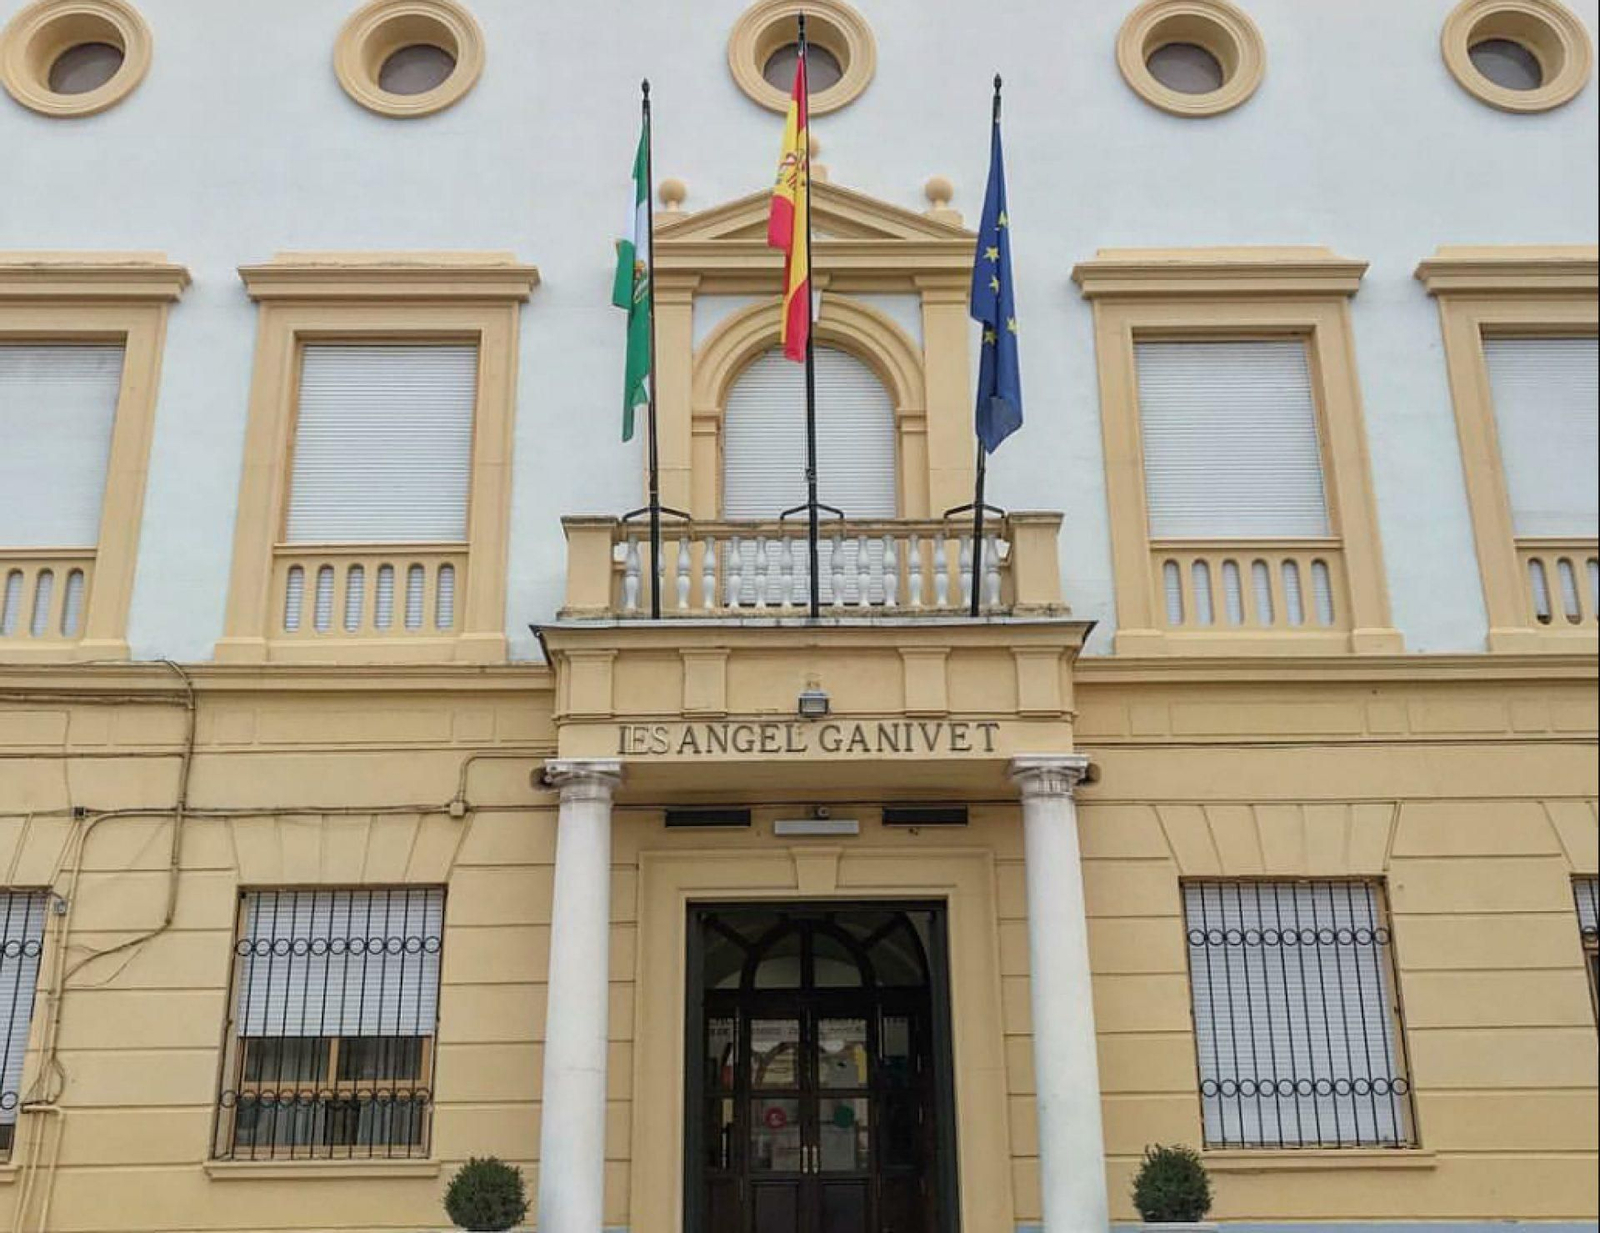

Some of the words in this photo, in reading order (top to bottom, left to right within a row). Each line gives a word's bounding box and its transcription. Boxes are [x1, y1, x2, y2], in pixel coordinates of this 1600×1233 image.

[618, 725, 669, 755] IES
[676, 723, 807, 754] ANGEL
[819, 723, 999, 753] GANIVET
